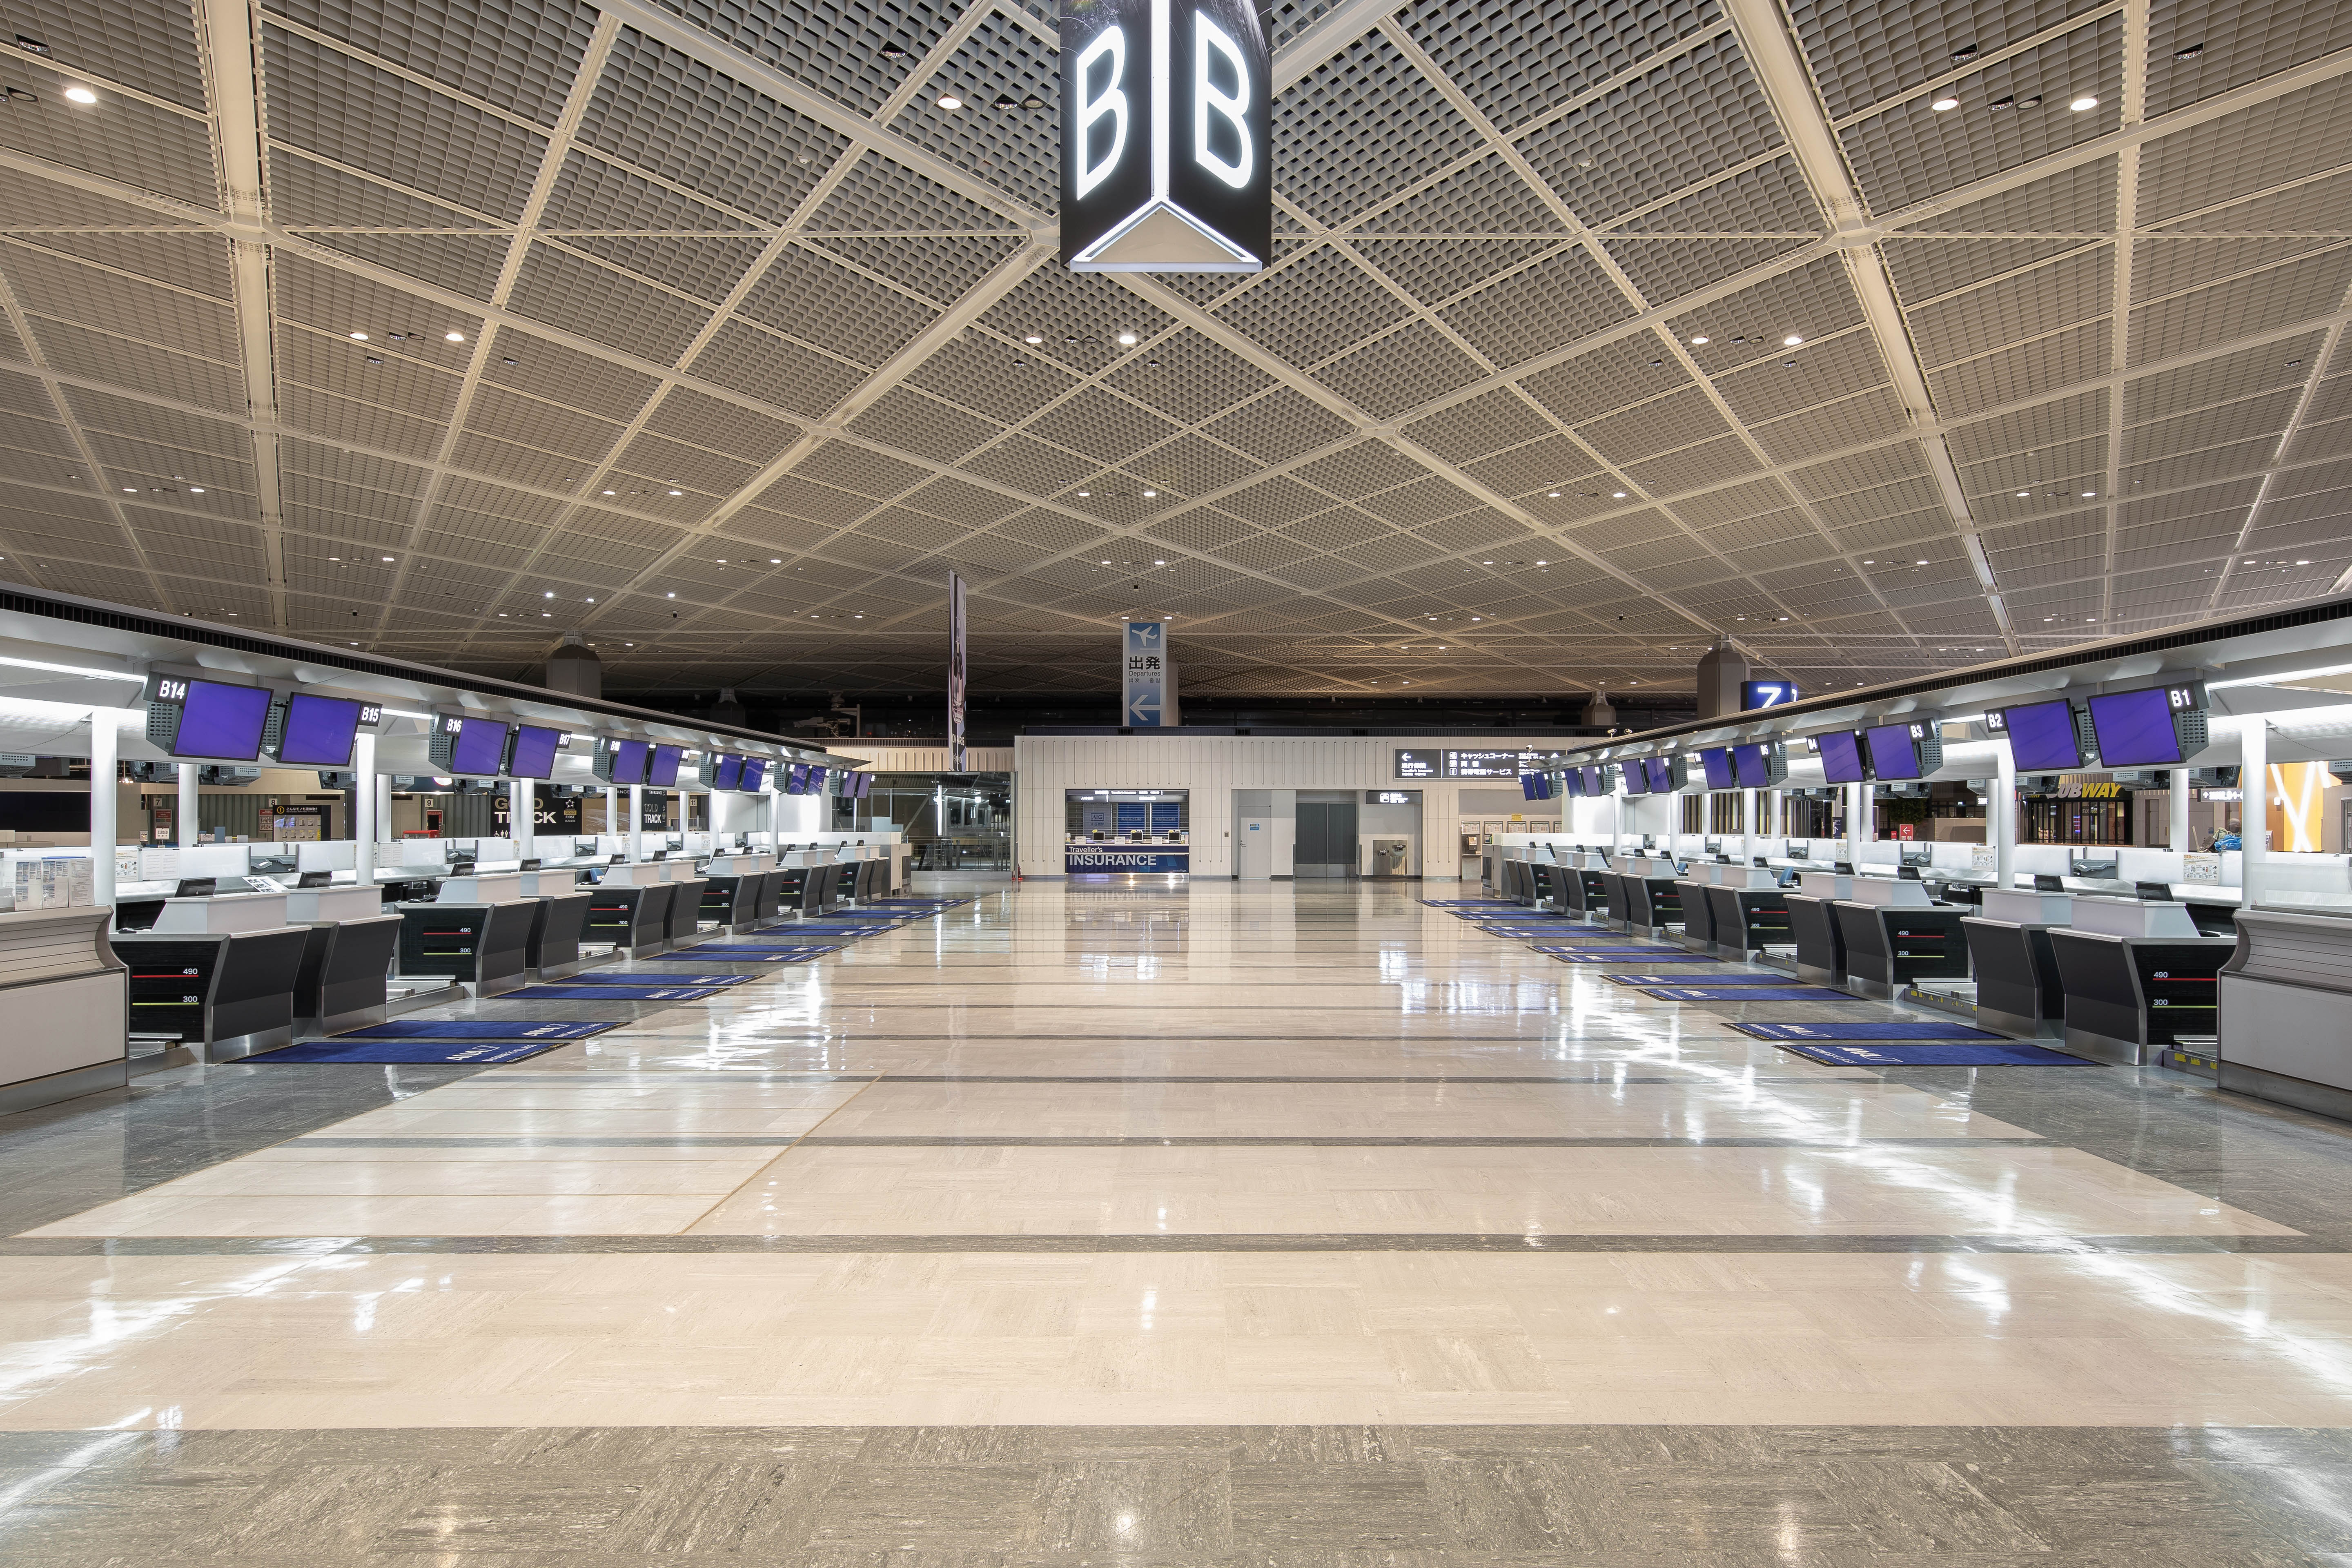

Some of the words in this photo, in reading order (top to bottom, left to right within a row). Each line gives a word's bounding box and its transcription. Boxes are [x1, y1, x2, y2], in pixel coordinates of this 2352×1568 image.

[1195, 9, 1253, 189] B
[1077, 25, 1128, 200] B
[1129, 656, 1160, 670] 出発
[159, 680, 186, 699] B14
[1757, 687, 1782, 708] 7
[2171, 689, 2190, 707] B1
[361, 707, 379, 722] B15
[1988, 713, 2002, 728] B2
[447, 719, 462, 733] B16
[1910, 725, 1923, 738] B3
[559, 734, 570, 745] B17
[1808, 739, 1817, 750] B4
[2046, 783, 2122, 799] UBWAY
[495, 797, 543, 809] GD
[644, 804, 658, 812] GOLD
[494, 812, 557, 823] TCK
[644, 814, 661, 823] TRACK
[1070, 855, 1156, 865] INSURANCE
[522, 1027, 560, 1036] ANA
[445, 1050, 486, 1060] ANA
